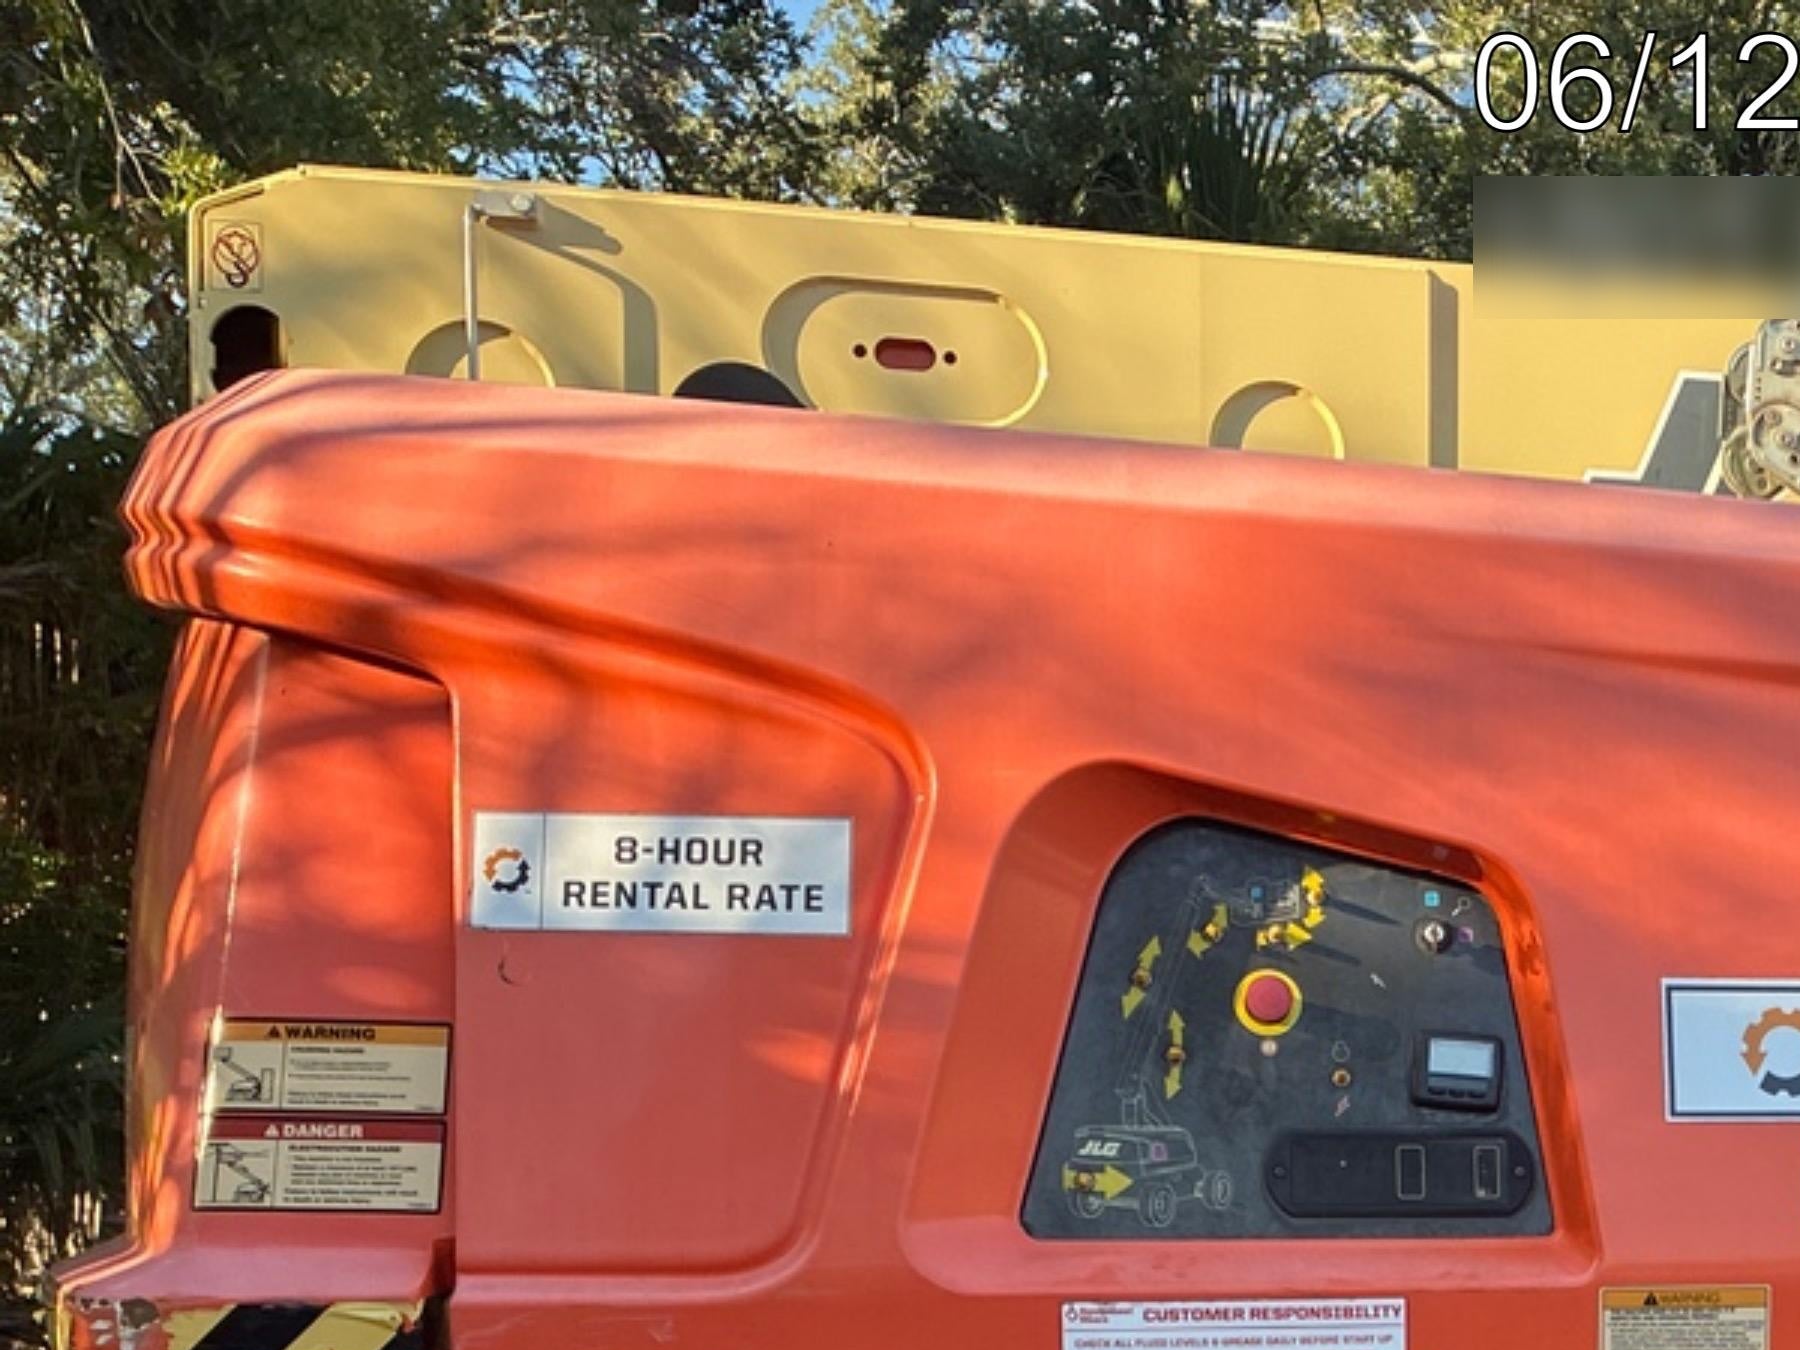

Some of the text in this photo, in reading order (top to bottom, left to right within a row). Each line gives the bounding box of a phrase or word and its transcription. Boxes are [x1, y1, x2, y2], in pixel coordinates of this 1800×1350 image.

[614, 836, 764, 868] 8-HOUR
[562, 880, 824, 913] RENTAL RATE
[285, 1026, 376, 1040] WARNING
[282, 1124, 364, 1138] DANGER
[1077, 1139, 1122, 1157] JLG
[1143, 1304, 1402, 1322] CUSTOMER RESPONSIBILITY
